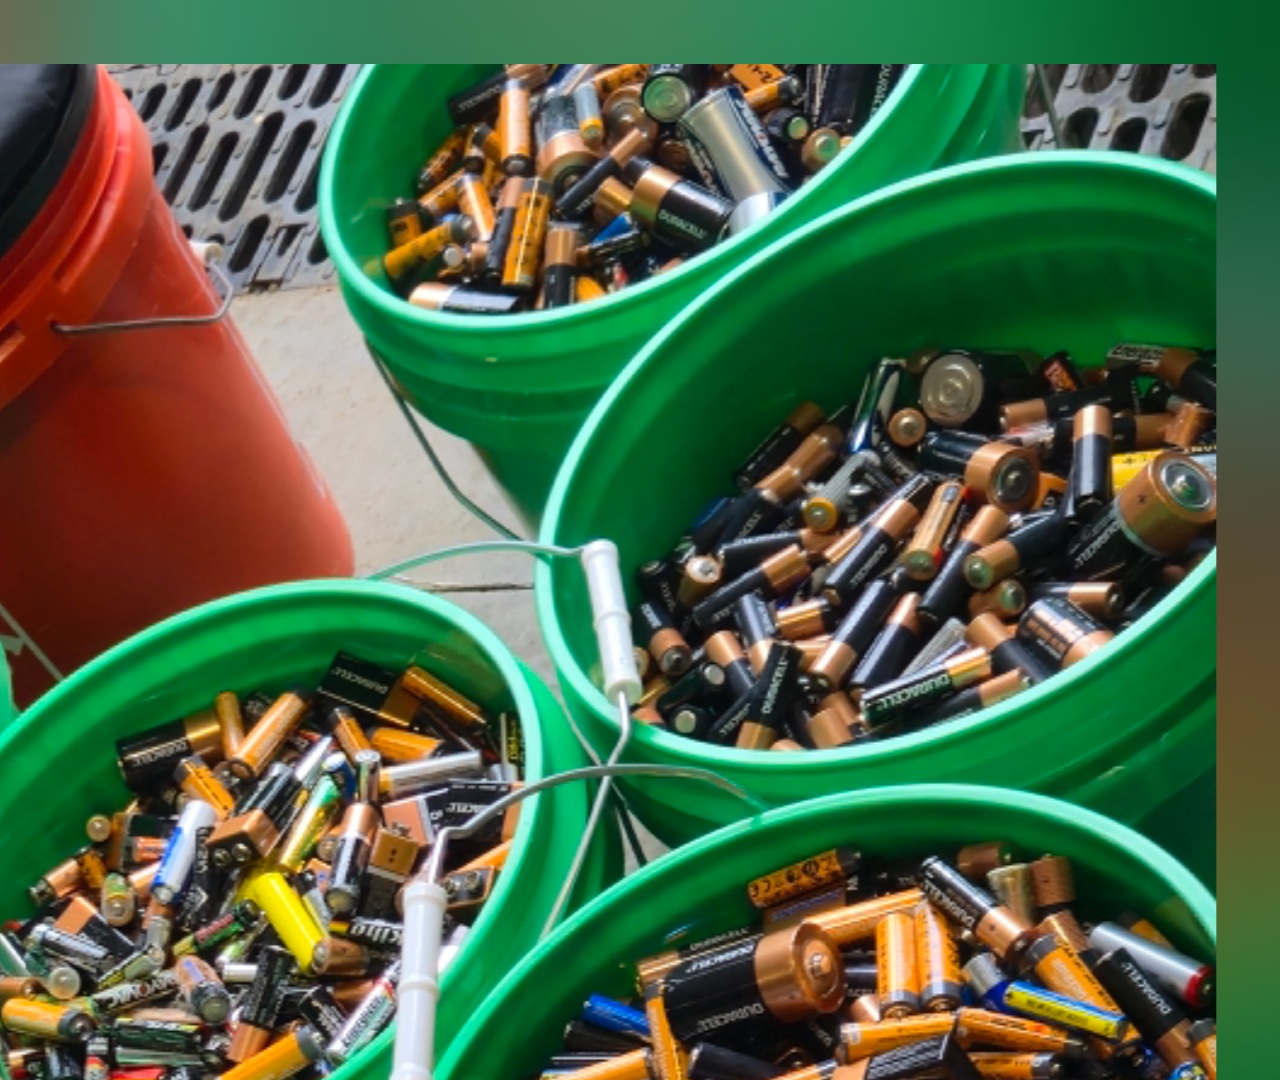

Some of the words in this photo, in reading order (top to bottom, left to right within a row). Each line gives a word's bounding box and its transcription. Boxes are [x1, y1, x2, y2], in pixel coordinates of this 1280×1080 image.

[657, 209, 709, 241] DURACELL
[1075, 520, 1120, 569] DURACELL
[850, 544, 887, 589] DURACELL
[333, 666, 389, 695] DURACELL
[762, 654, 789, 715] DURACELL
[877, 672, 951, 711] DURACELL
[132, 739, 188, 768] DURACELL
[922, 879, 976, 926] DURACELL
[1121, 961, 1173, 1016] DURACELL
[697, 1002, 765, 1033] DURACELL
